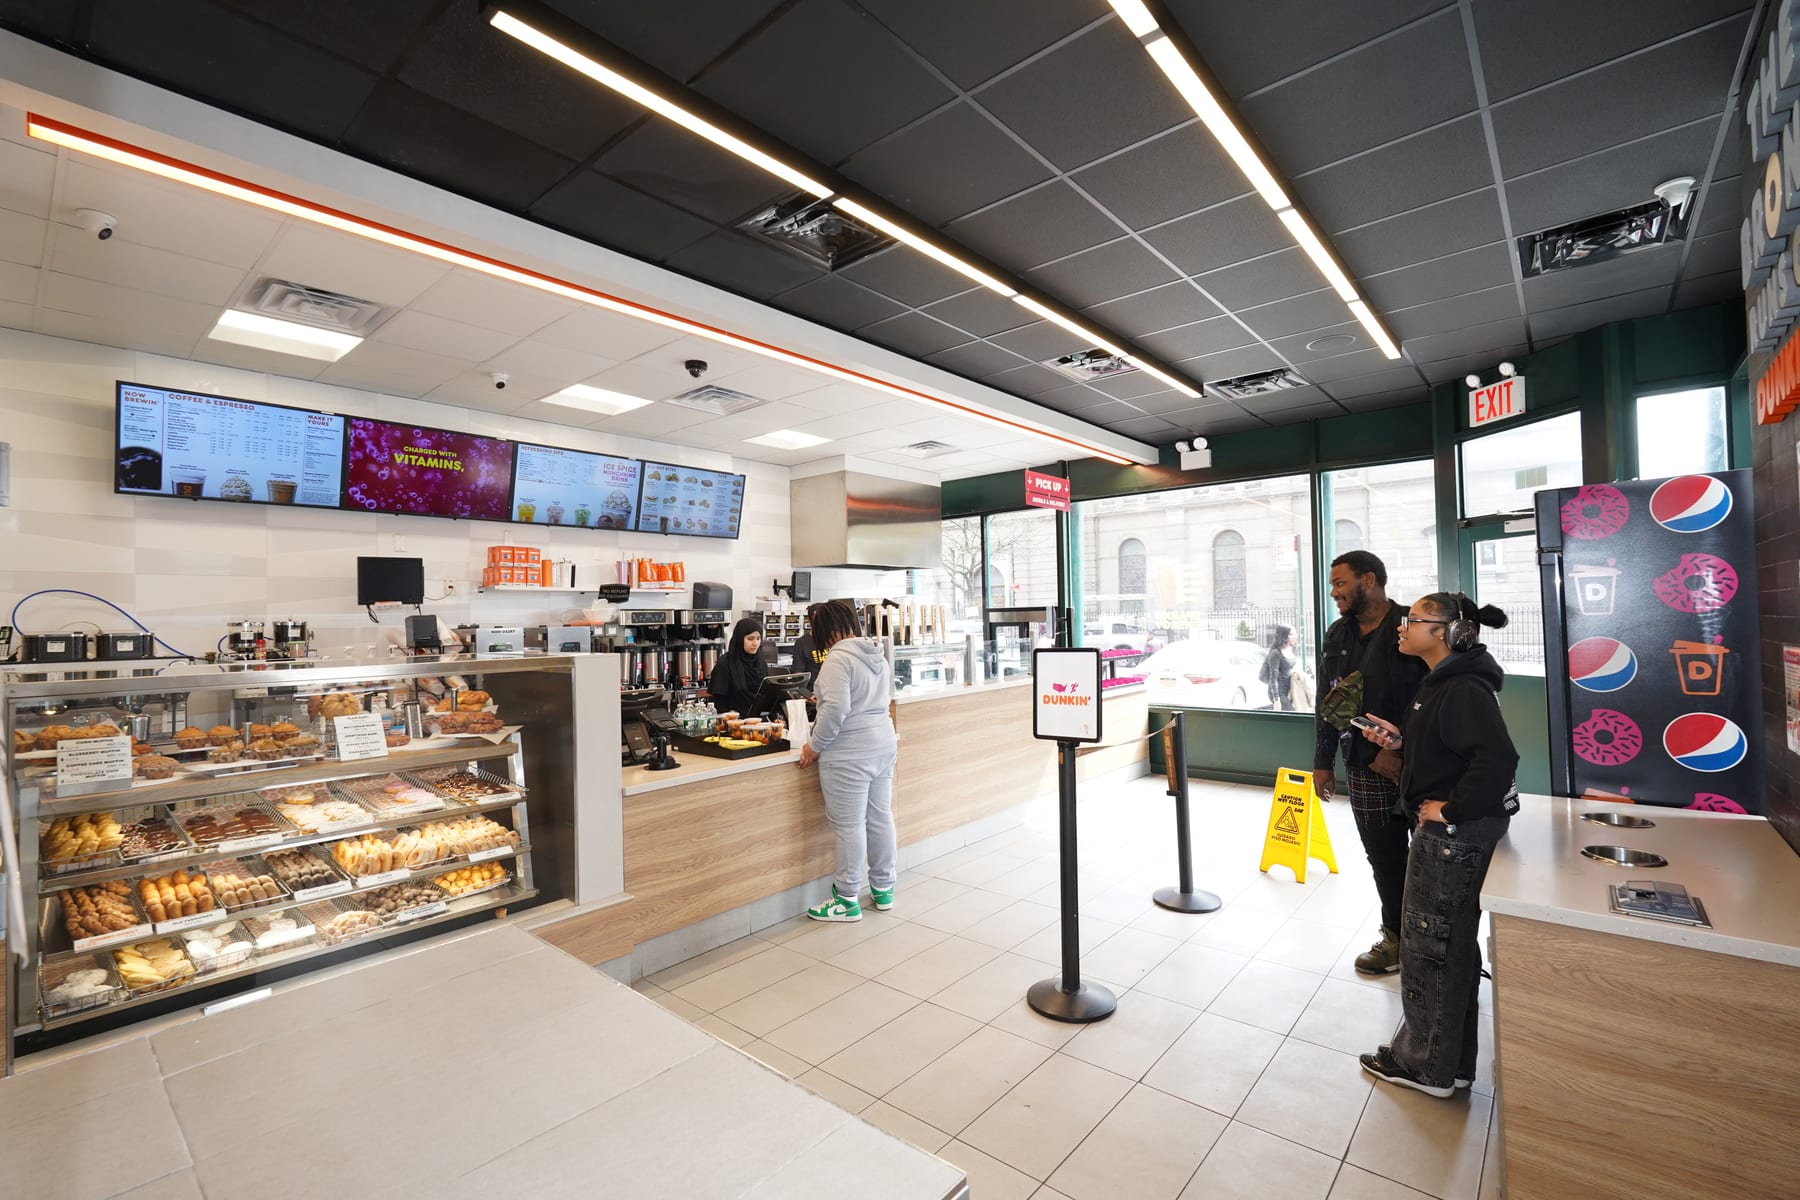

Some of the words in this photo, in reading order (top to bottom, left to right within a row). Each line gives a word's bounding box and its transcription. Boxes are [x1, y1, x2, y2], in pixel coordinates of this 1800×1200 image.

[168, 393, 204, 404] COFFEE
[213, 399, 255, 411] ESPRESSO
[1475, 381, 1514, 423] EXIT
[403, 445, 437, 456] CHARGED
[438, 449, 457, 458] WITH
[393, 452, 465, 472] VITAMINS,
[617, 465, 637, 473] SPICE
[1035, 477, 1052, 491] PICK
[1053, 481, 1062, 492] UP
[1585, 583, 1607, 600] D
[1687, 661, 1713, 680] D
[1043, 694, 1091, 706] DUNKIN'
